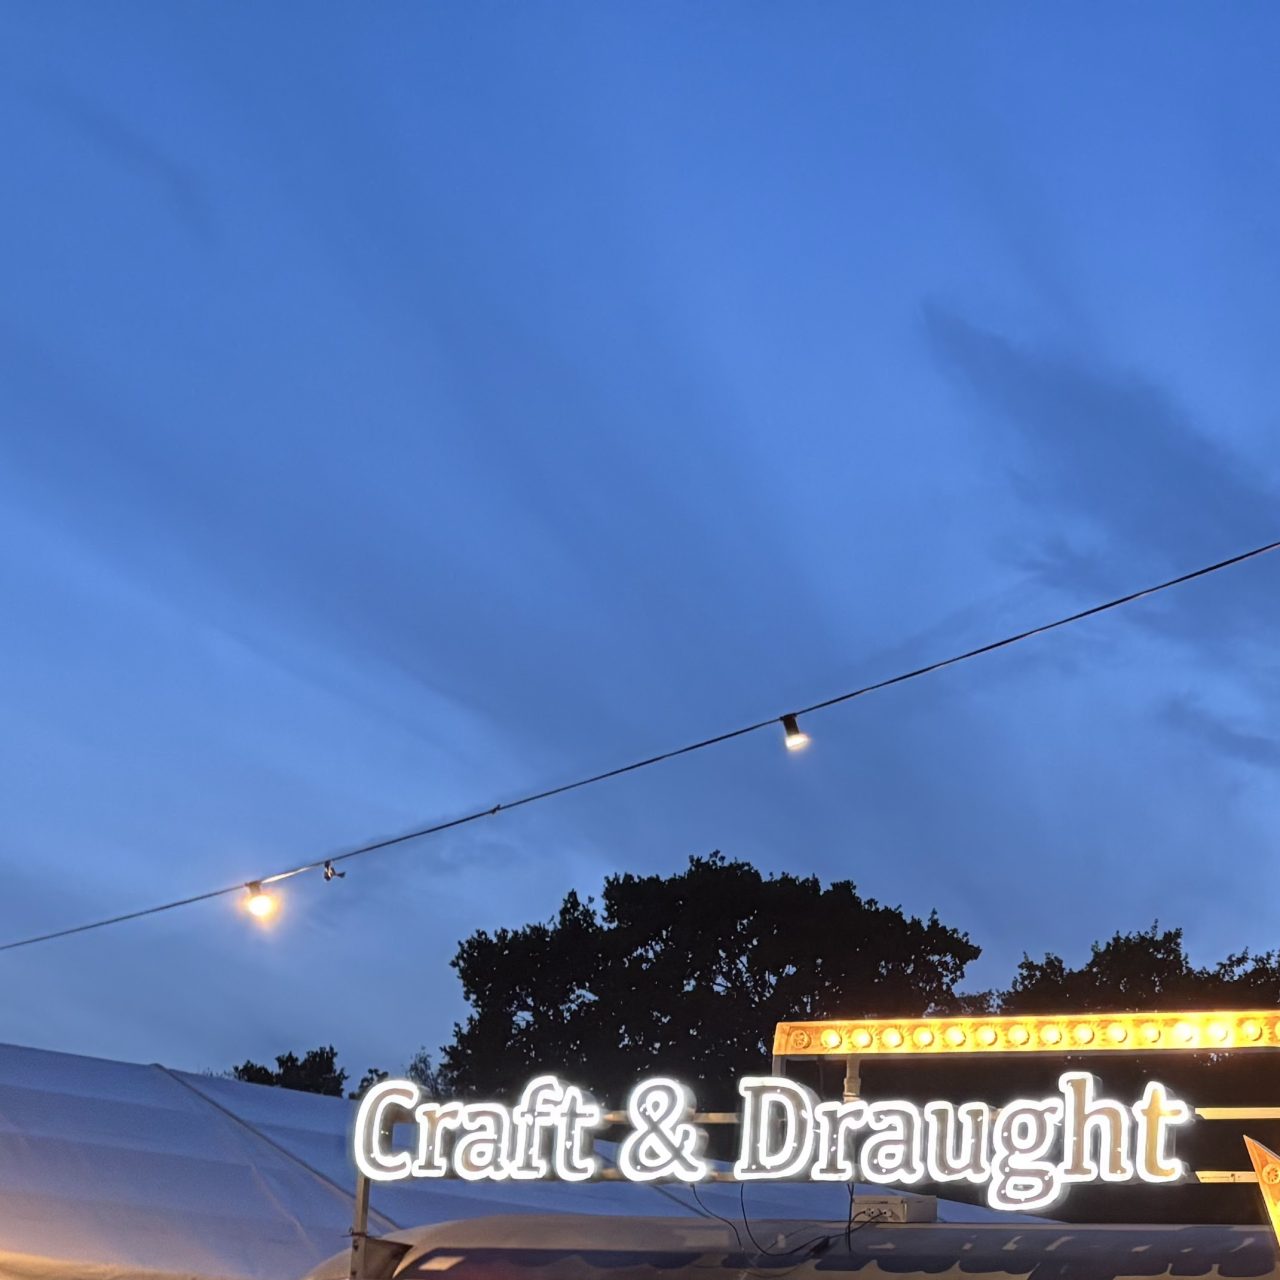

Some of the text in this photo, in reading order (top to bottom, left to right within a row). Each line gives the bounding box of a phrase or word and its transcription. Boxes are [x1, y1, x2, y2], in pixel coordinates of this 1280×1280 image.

[353, 1071, 1203, 1211] Craft & Draught
